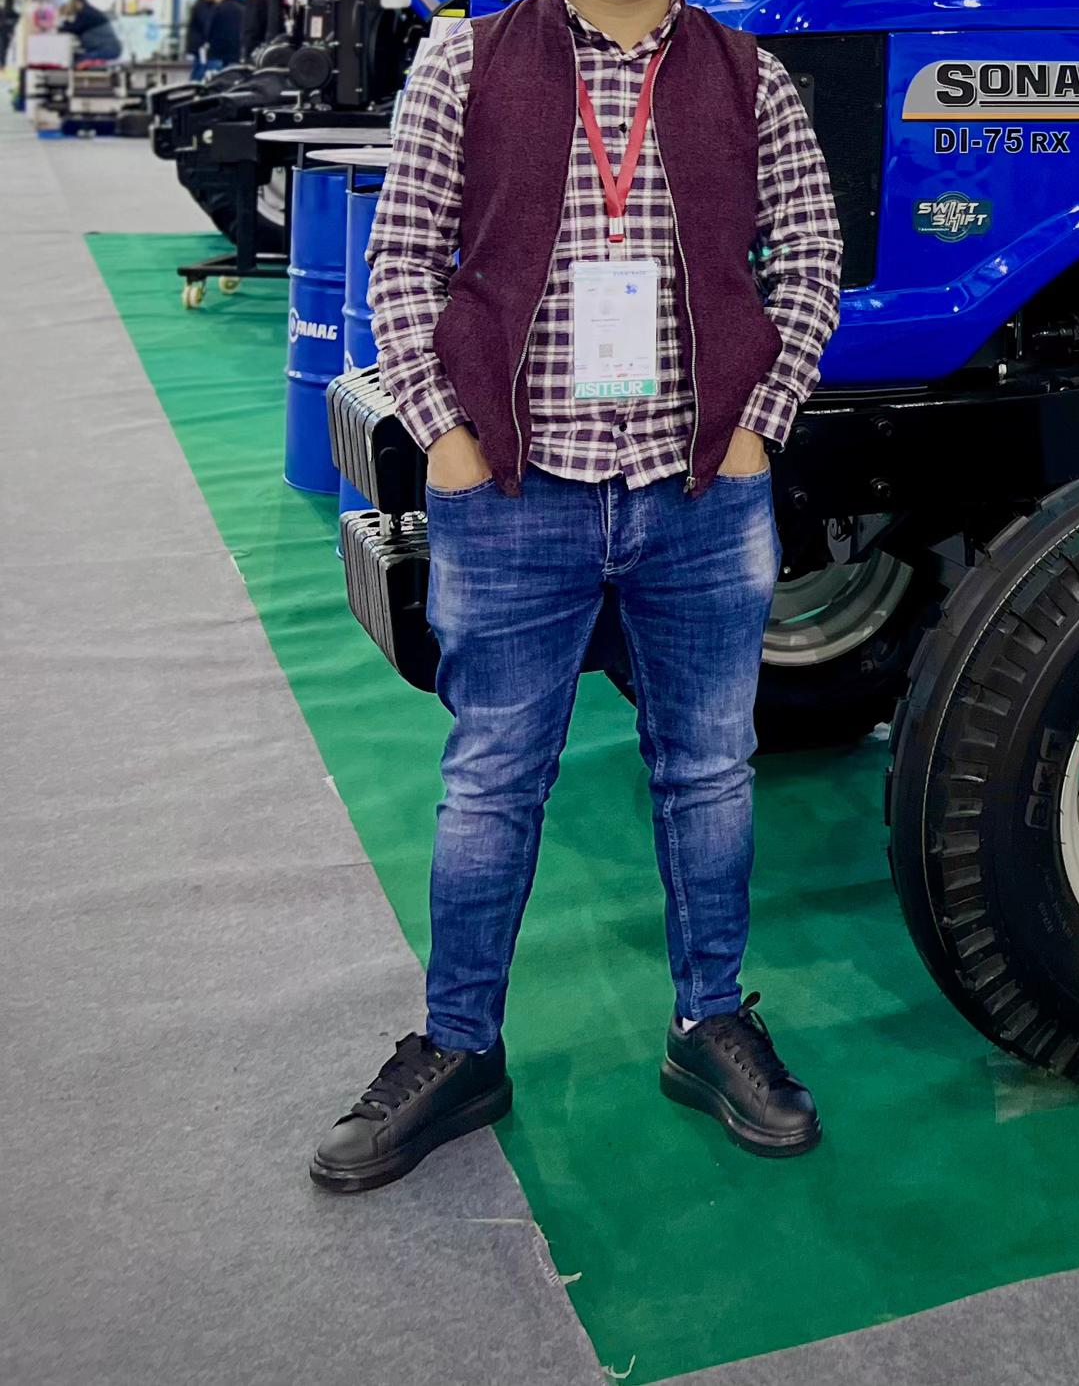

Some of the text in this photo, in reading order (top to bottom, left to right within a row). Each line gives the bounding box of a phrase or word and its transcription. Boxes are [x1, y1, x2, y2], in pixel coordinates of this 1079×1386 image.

[934, 127, 1071, 154] DI-75 RX
[917, 202, 980, 215] SWIFT
[931, 213, 989, 227] SHIFT
[575, 381, 644, 397] VISITEUR
